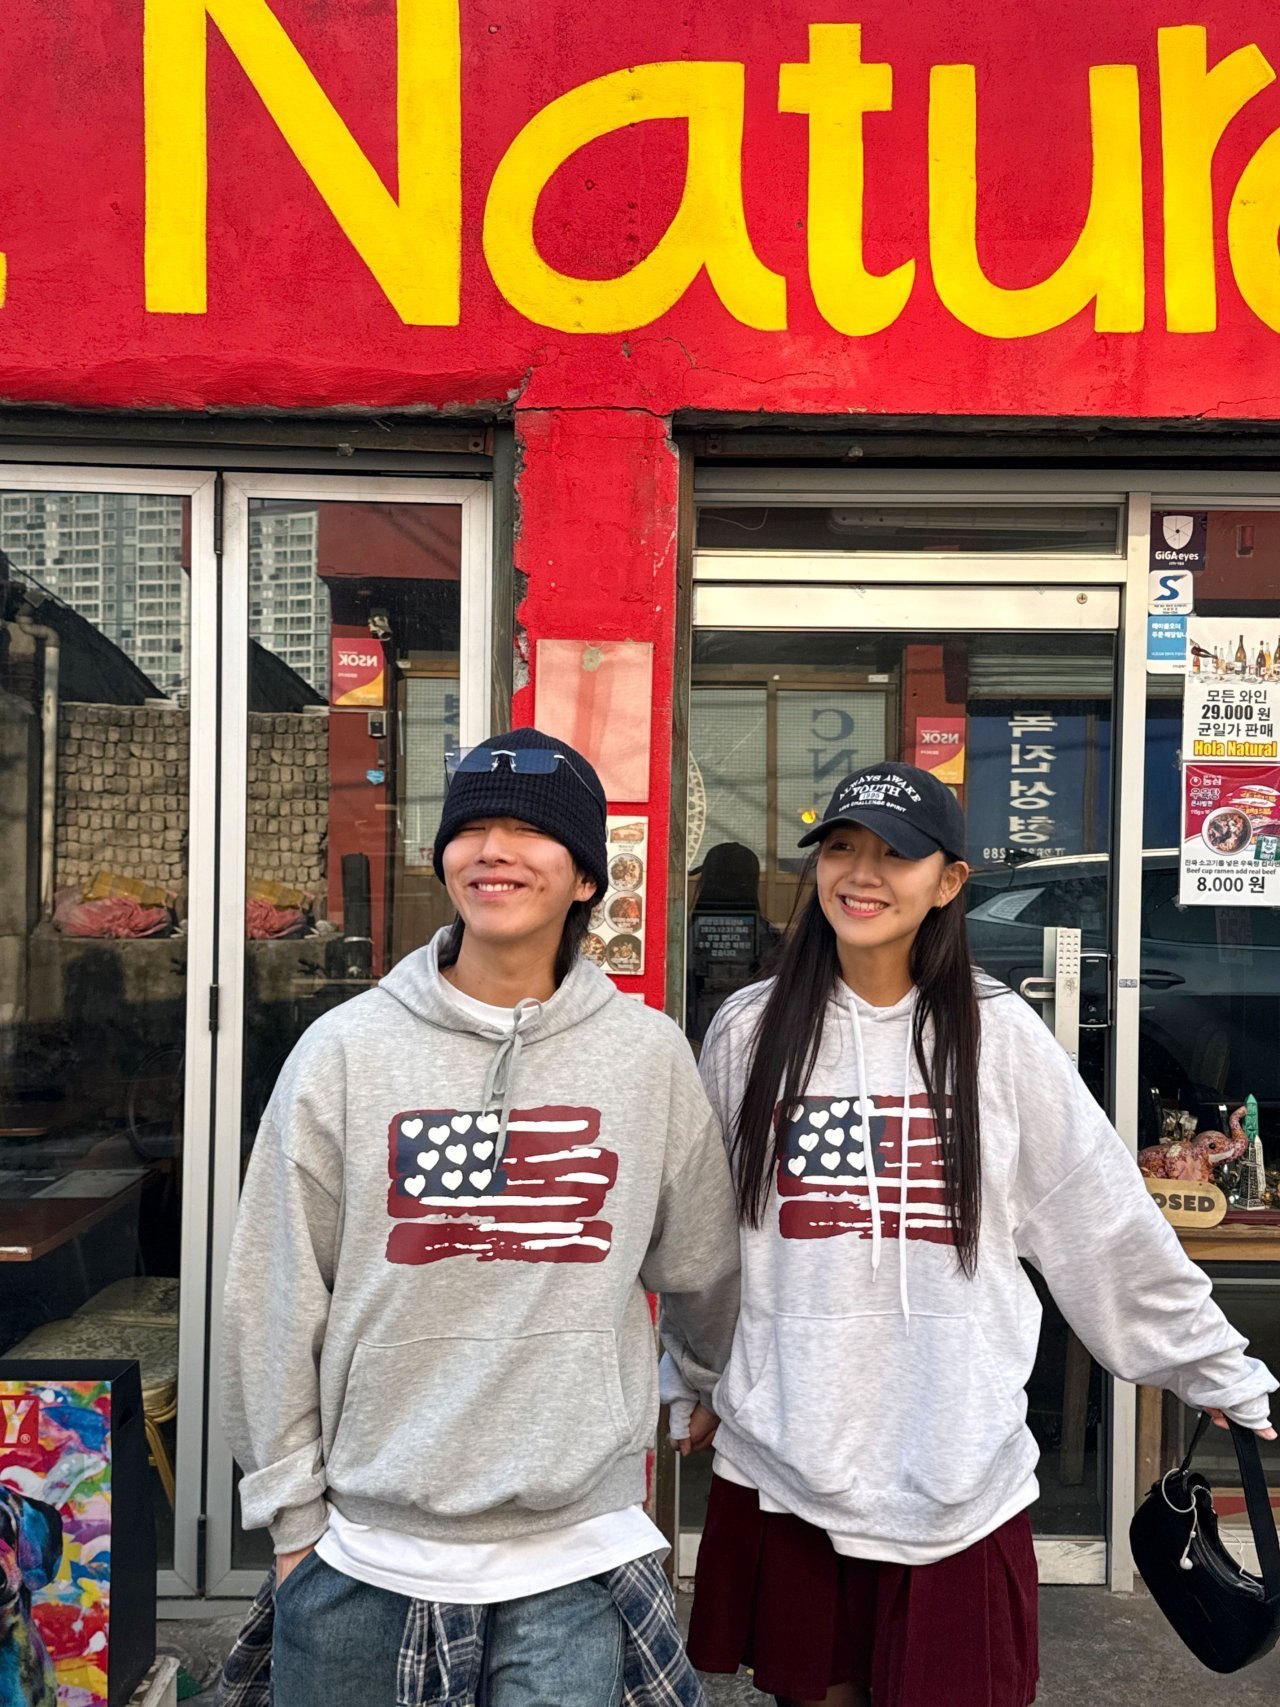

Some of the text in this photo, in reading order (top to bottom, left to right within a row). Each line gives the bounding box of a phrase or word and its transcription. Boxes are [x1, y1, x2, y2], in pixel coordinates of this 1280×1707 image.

[144, 0, 1280, 338] Natur
[1206, 690, 1267, 704] 모든 와인
[1202, 704, 1271, 721] 29.000 원
[1198, 722, 1274, 738] 균일가 판매
[1193, 740, 1278, 758] Hola Natural
[840, 775, 882, 801] ALWAYS
[882, 774, 922, 802] AWAKE
[851, 784, 902, 797] YOUTH
[886, 802, 907, 812] SPIRIT
[1197, 876, 1265, 894] 8.000 원
[1151, 1193, 1216, 1212] OSED
